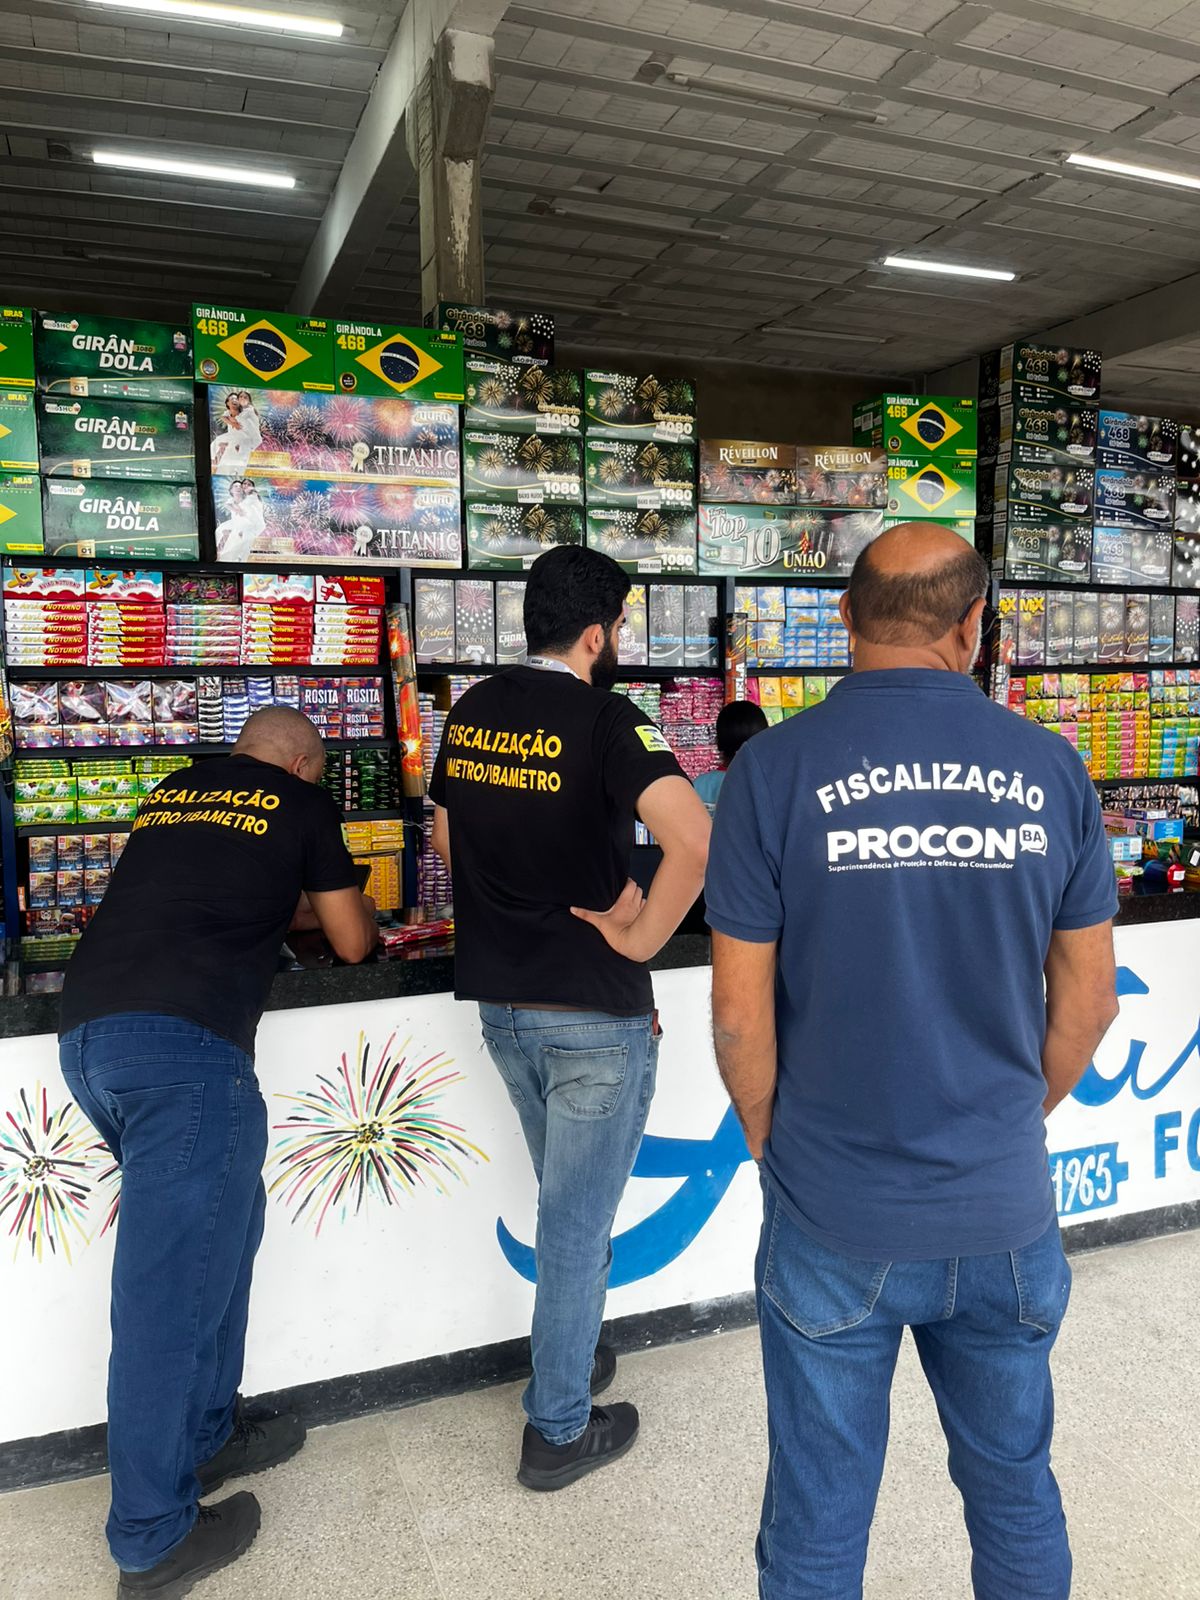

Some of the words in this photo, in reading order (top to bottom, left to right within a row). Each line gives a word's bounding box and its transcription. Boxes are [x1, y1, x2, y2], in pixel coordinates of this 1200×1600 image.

[197, 319, 228, 336] 468
[72, 333, 134, 354] GIRÂN
[337, 334, 365, 350] 468
[99, 353, 154, 372] DOLA
[1025, 358, 1048, 374] 468
[887, 405, 908, 418] 468
[74, 416, 136, 435] GIRÂN
[544, 412, 580, 427] 1080
[1025, 418, 1048, 433] 468
[660, 421, 693, 434] 1080
[1108, 427, 1130, 441] 468
[102, 435, 155, 452] DOLA
[373, 445, 457, 470] TITANIC
[719, 445, 779, 465] RÉVEILLON
[814, 452, 872, 471] RÉVEILLON
[888, 467, 907, 480] 468
[544, 482, 580, 495] 1080
[1019, 478, 1041, 492] 468
[1104, 484, 1125, 499] 468
[660, 488, 693, 501] 1080
[79, 496, 140, 515] GIRÂN
[106, 515, 160, 532] DOLA
[709, 512, 747, 542] Top
[377, 529, 459, 552] TITANIC
[738, 524, 782, 572] 10
[1017, 537, 1040, 551] 468
[1102, 541, 1124, 556] 468
[661, 554, 694, 566] 1080
[783, 549, 827, 569] UNIÃO
[46, 603, 81, 611] NOTURNO
[48, 646, 83, 654] NOTURNO
[305, 689, 339, 704] ROSITA
[347, 688, 380, 703] ROSITA
[307, 714, 328, 724] OSITA
[346, 714, 369, 723] ROSITA
[346, 727, 369, 737] ROSITA
[448, 725, 562, 762] FISCALIZAÇÃO
[816, 763, 1045, 814] FISCALIZAÇÃO
[827, 825, 1016, 862] PROCON
[1022, 830, 1043, 843] BA
[828, 862, 892, 872] Superintendência
[900, 860, 927, 868] Proteção
[934, 859, 957, 867] Defesa
[959, 860, 968, 868] do
[970, 861, 1014, 869] Consumidor
[1052, 1152, 1113, 1212] 1965
